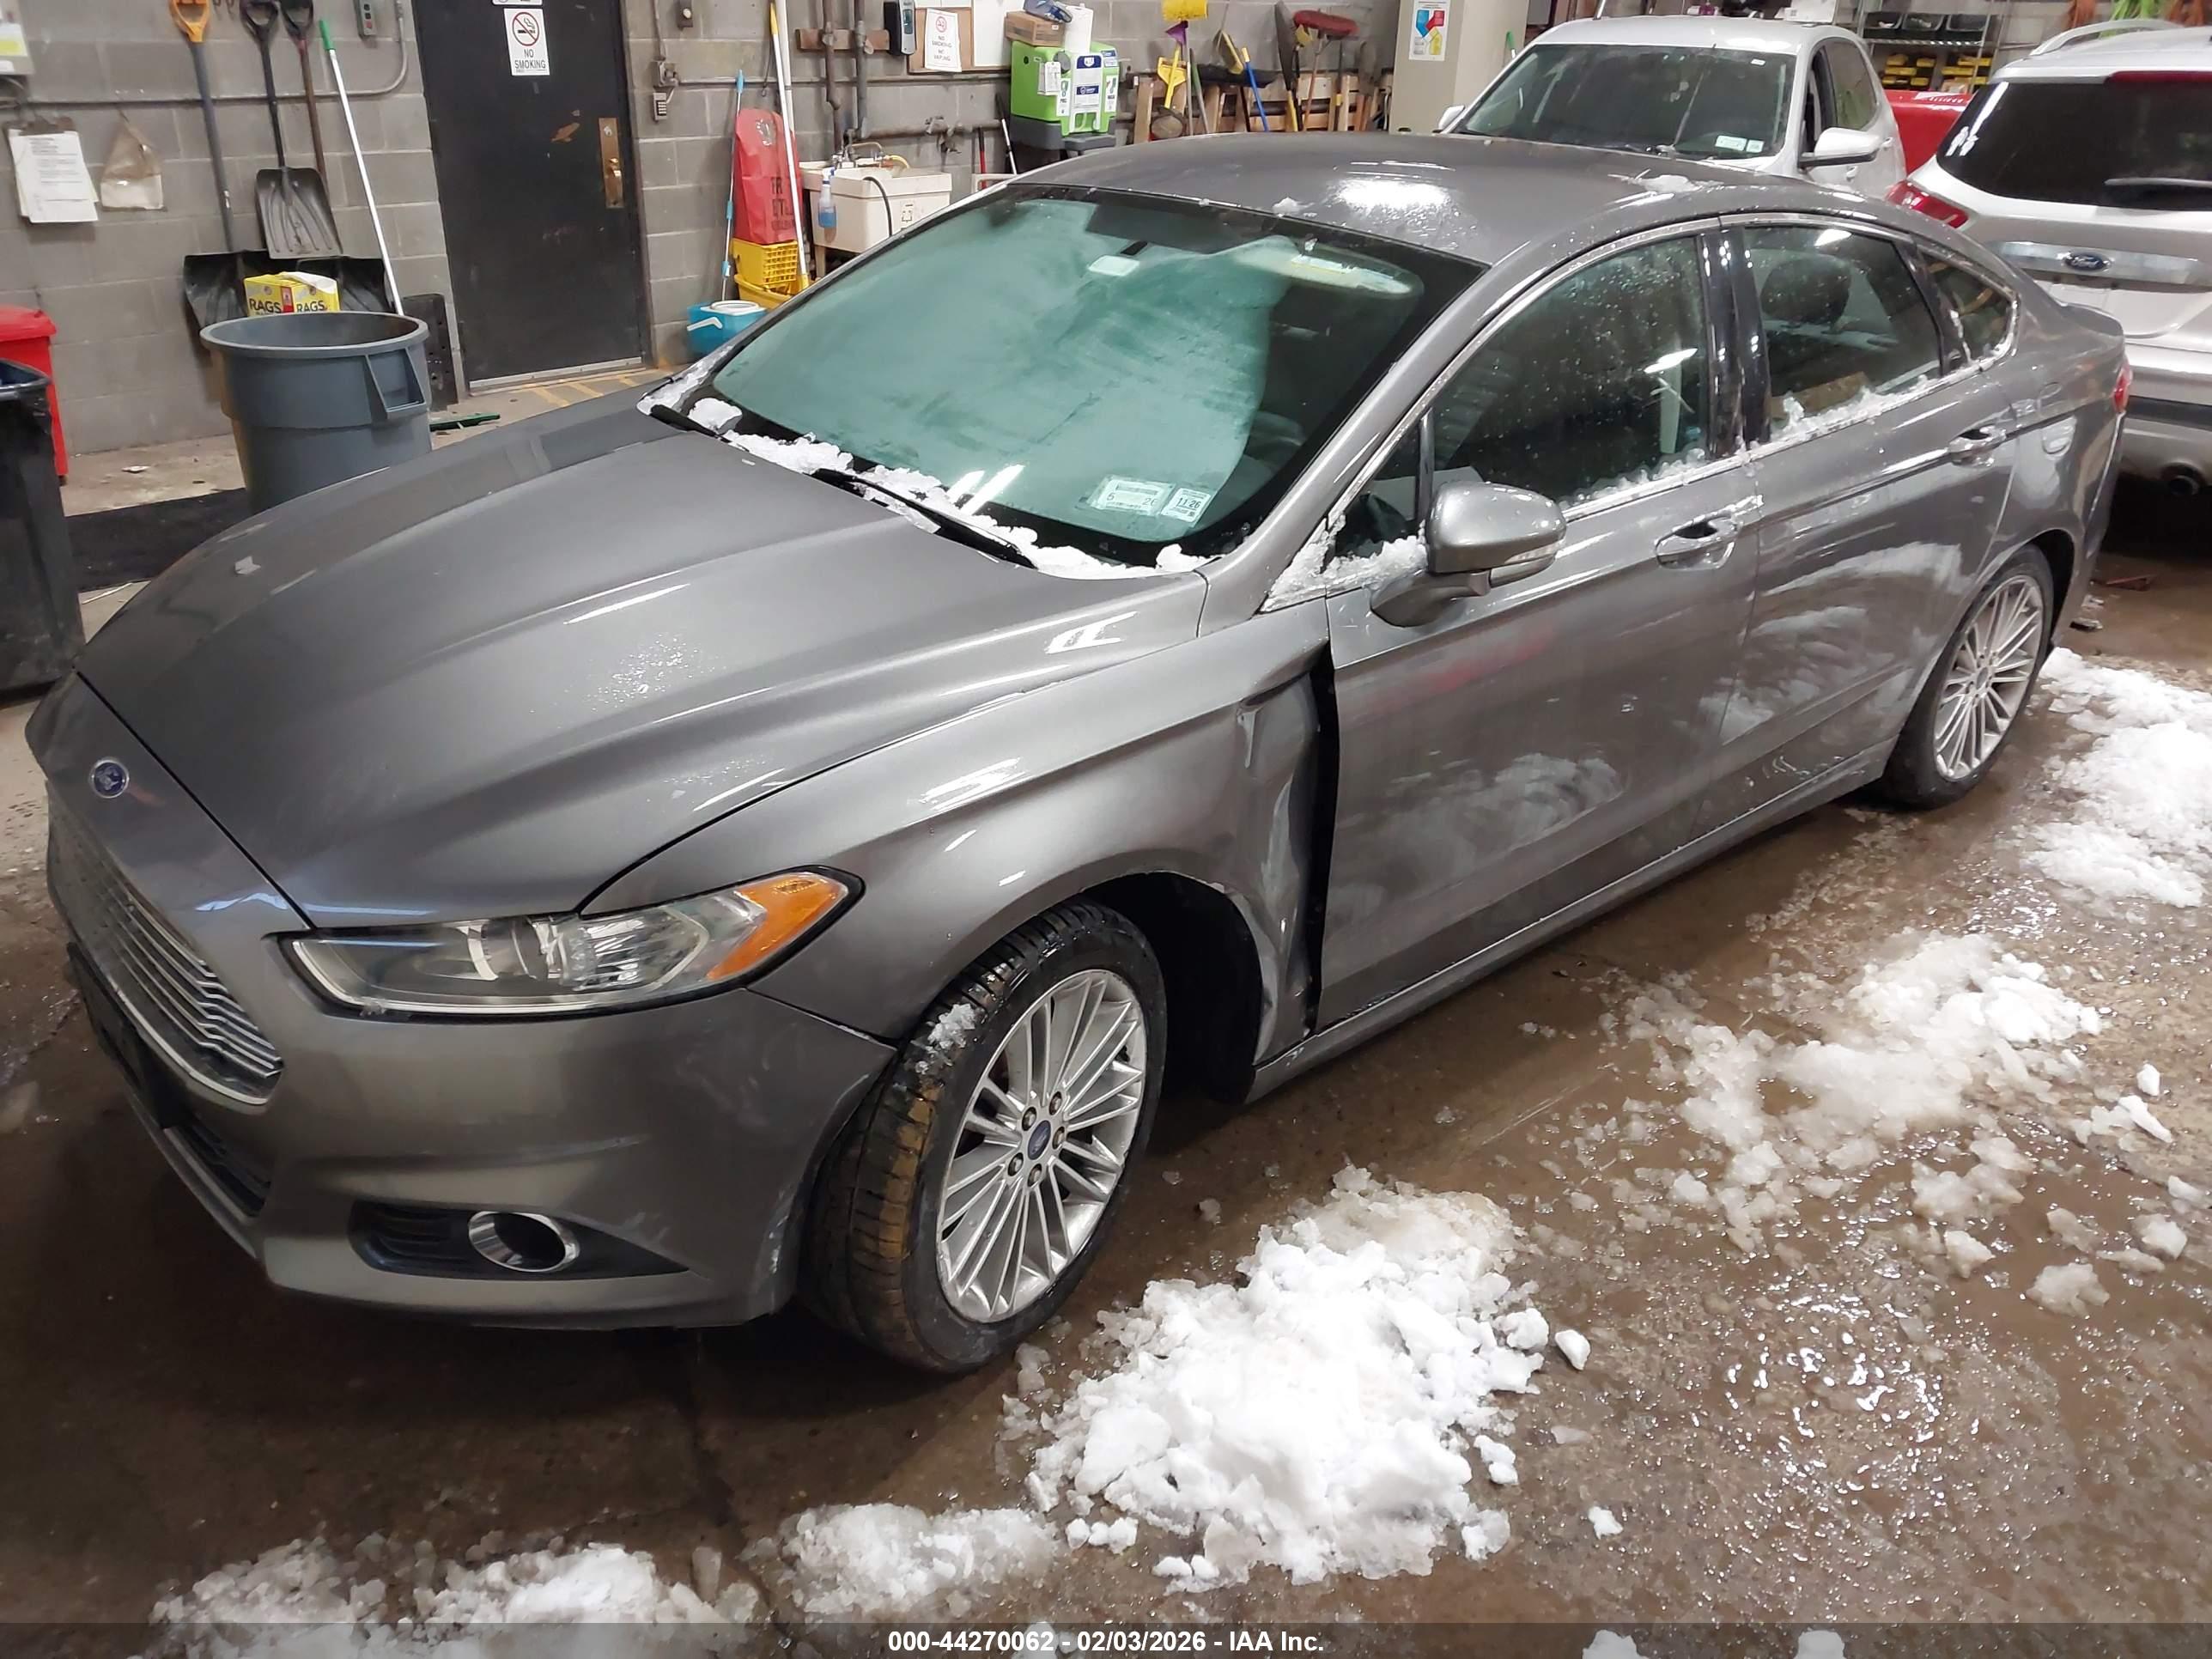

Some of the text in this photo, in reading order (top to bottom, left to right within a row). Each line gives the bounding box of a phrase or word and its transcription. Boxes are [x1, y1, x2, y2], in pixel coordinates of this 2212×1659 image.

[524, 49, 534, 58] NO
[515, 59, 546, 70] SMOKING
[249, 297, 282, 314] RAGS
[296, 300, 325, 313] RAGS
